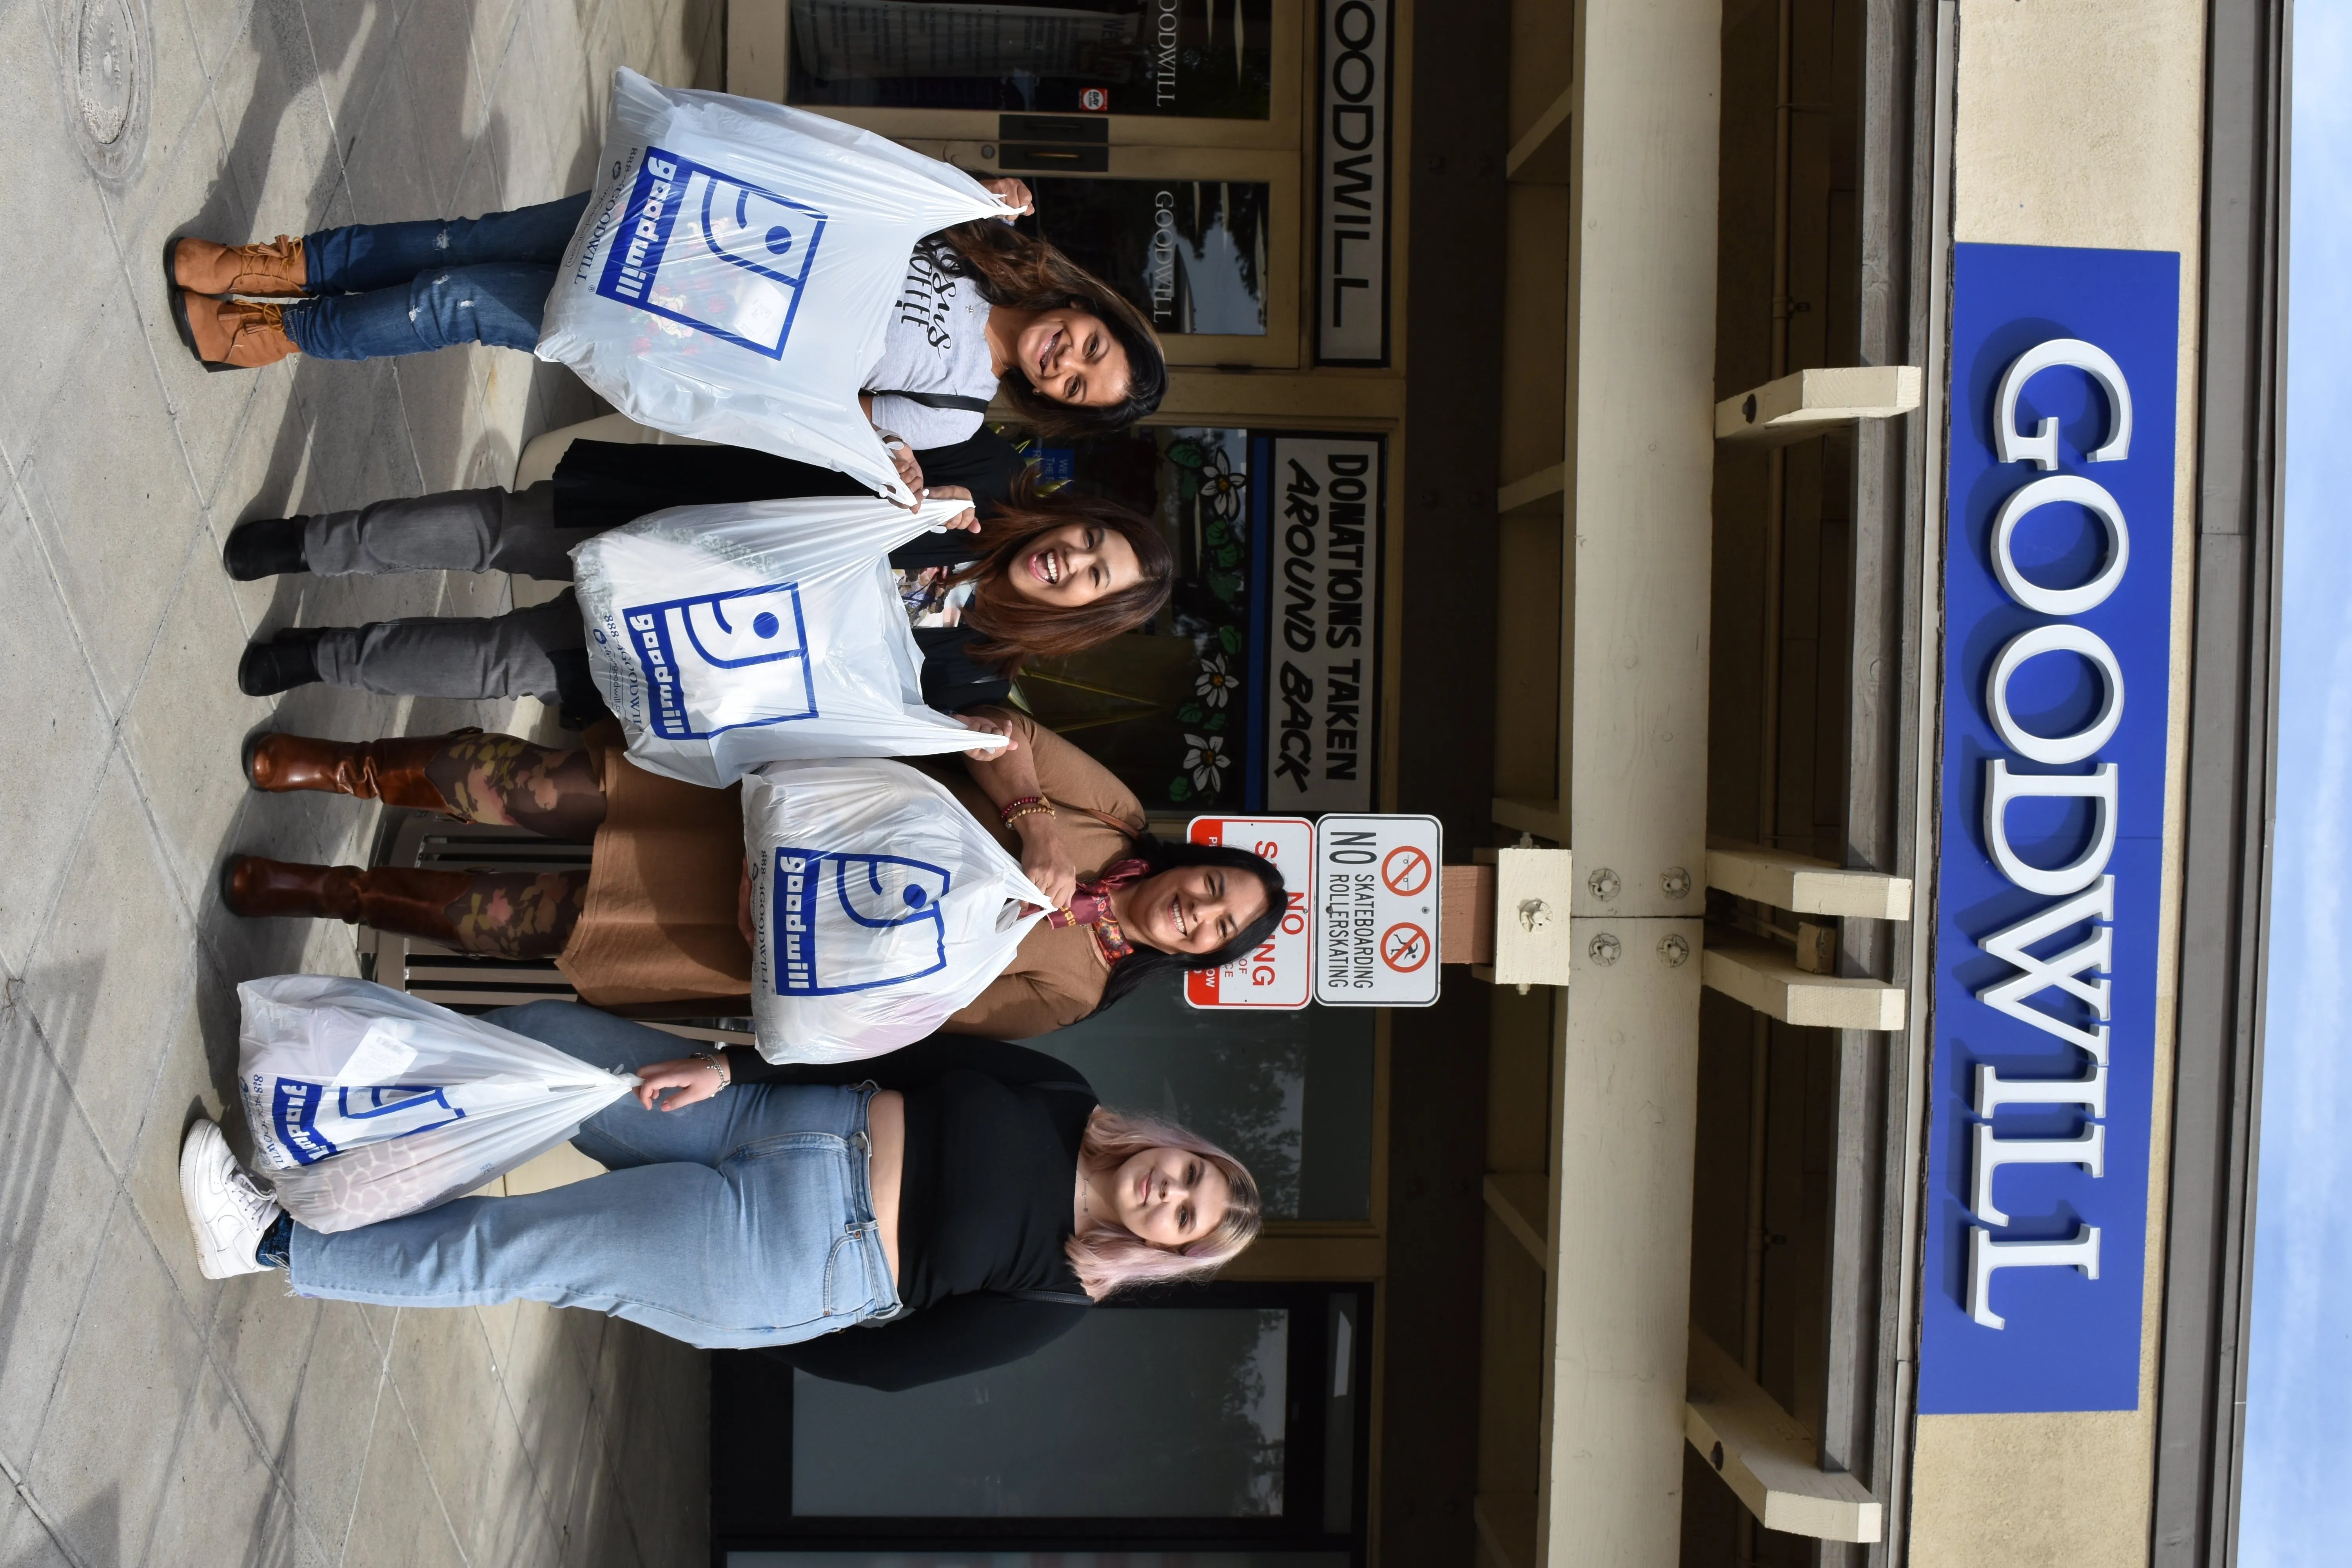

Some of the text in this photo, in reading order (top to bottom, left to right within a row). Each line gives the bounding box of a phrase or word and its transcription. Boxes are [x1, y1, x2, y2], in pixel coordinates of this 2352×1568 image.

[1156, 0, 1177, 107] OODWILL
[1333, 0, 1376, 328] OODWILL
[615, 156, 677, 299] goodwill
[1153, 191, 1174, 323] GOODWILL
[901, 256, 933, 332] OFFEE
[1045, 457, 1055, 474] THE
[1059, 459, 1069, 474] WE
[604, 615, 642, 724] 888-4GOODWI
[629, 613, 685, 734] goodwill
[1273, 458, 1321, 793] AROUND BACK
[1325, 454, 1369, 780] DONATIONS TAKEN
[1329, 831, 1377, 864] NO
[1965, 338, 2132, 1329] GOODWILL
[780, 856, 809, 988] goodwill
[1238, 958, 1247, 975] OF
[1281, 892, 1305, 935] NO
[1328, 874, 1350, 988] ROLLERSKATING
[1353, 874, 1375, 989] SKATEBOARDING
